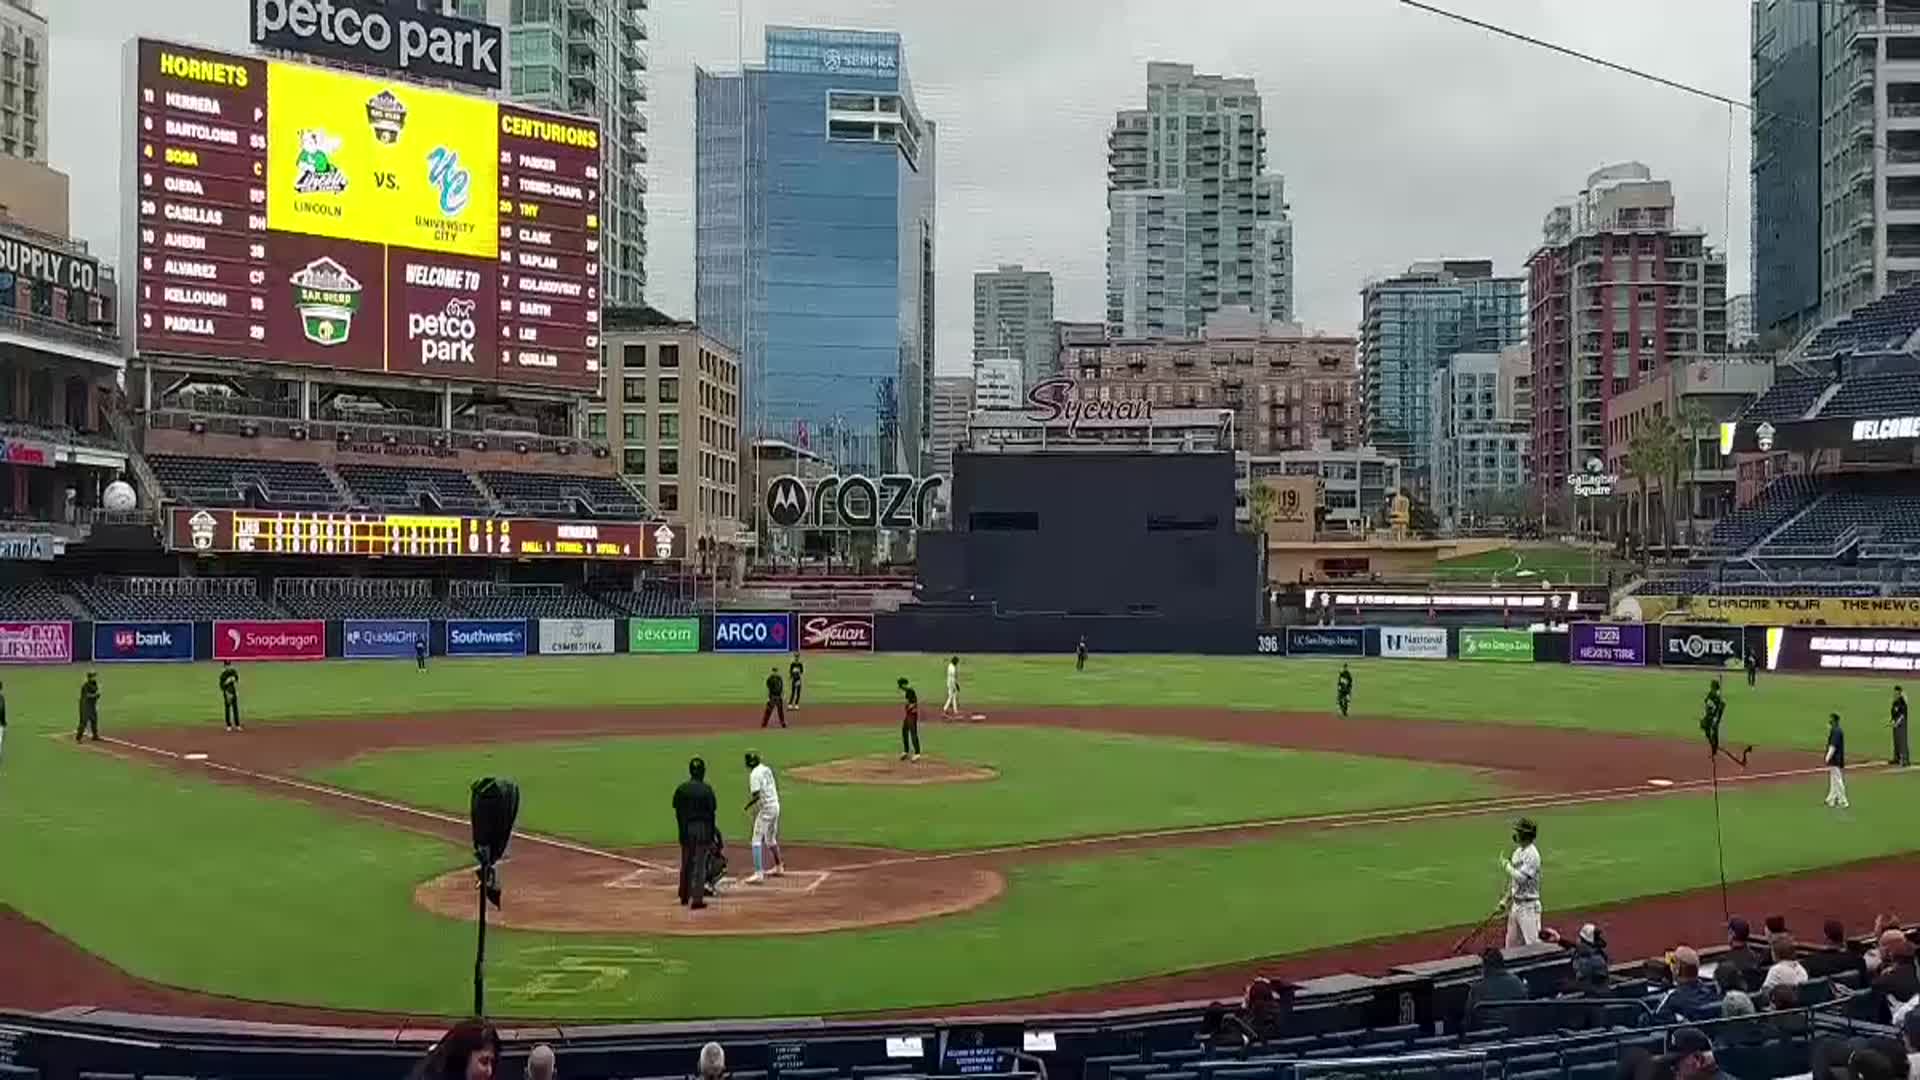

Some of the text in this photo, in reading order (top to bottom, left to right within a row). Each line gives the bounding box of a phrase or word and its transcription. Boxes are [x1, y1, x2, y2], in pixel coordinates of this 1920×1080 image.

[256, 0, 497, 73] petco park
[161, 53, 248, 87] HORNETS
[844, 55, 896, 68] SEMPRA
[165, 92, 221, 115] HERRERA
[501, 115, 598, 148] CENTURIONS
[165, 148, 199, 166] SOSA
[253, 161, 263, 176] C
[164, 177, 204, 195] OJEDA
[164, 204, 223, 226] CASILLAS
[294, 200, 342, 217] LINCOLN
[415, 215, 476, 233] UNIVERSITY
[164, 232, 206, 250] AHERN
[434, 230, 457, 242] CITY
[519, 228, 552, 245] CLARK
[164, 260, 217, 279] ALVAREZ
[519, 253, 558, 269] KAPLAN
[69, 260, 97, 294] CO.
[405, 263, 481, 292] WELCOME TO
[502, 274, 509, 288] 7
[588, 287, 596, 299] C
[164, 288, 228, 307] KELLOUGH
[164, 316, 216, 335] PADILLA
[409, 311, 476, 340] petco
[519, 327, 537, 340] LEE
[421, 338, 476, 365] park
[1027, 374, 1153, 439] Sycuan
[1567, 474, 1618, 487] Gallagher
[1574, 483, 1611, 496] Square
[812, 473, 945, 528] razr
[469, 533, 511, 553] 0 1 2
[1708, 599, 1820, 610] CHROME TOUR
[1841, 600, 1871, 611] THE
[1872, 600, 1906, 611] NEW
[136, 631, 172, 645] bank
[246, 631, 318, 649] Snapdragon
[451, 629, 515, 644] Southwest
[716, 622, 767, 642] ARCO
[804, 617, 865, 647] Sycuan
[1258, 636, 1279, 652] 396
[1669, 635, 1734, 657] EVOTEK
